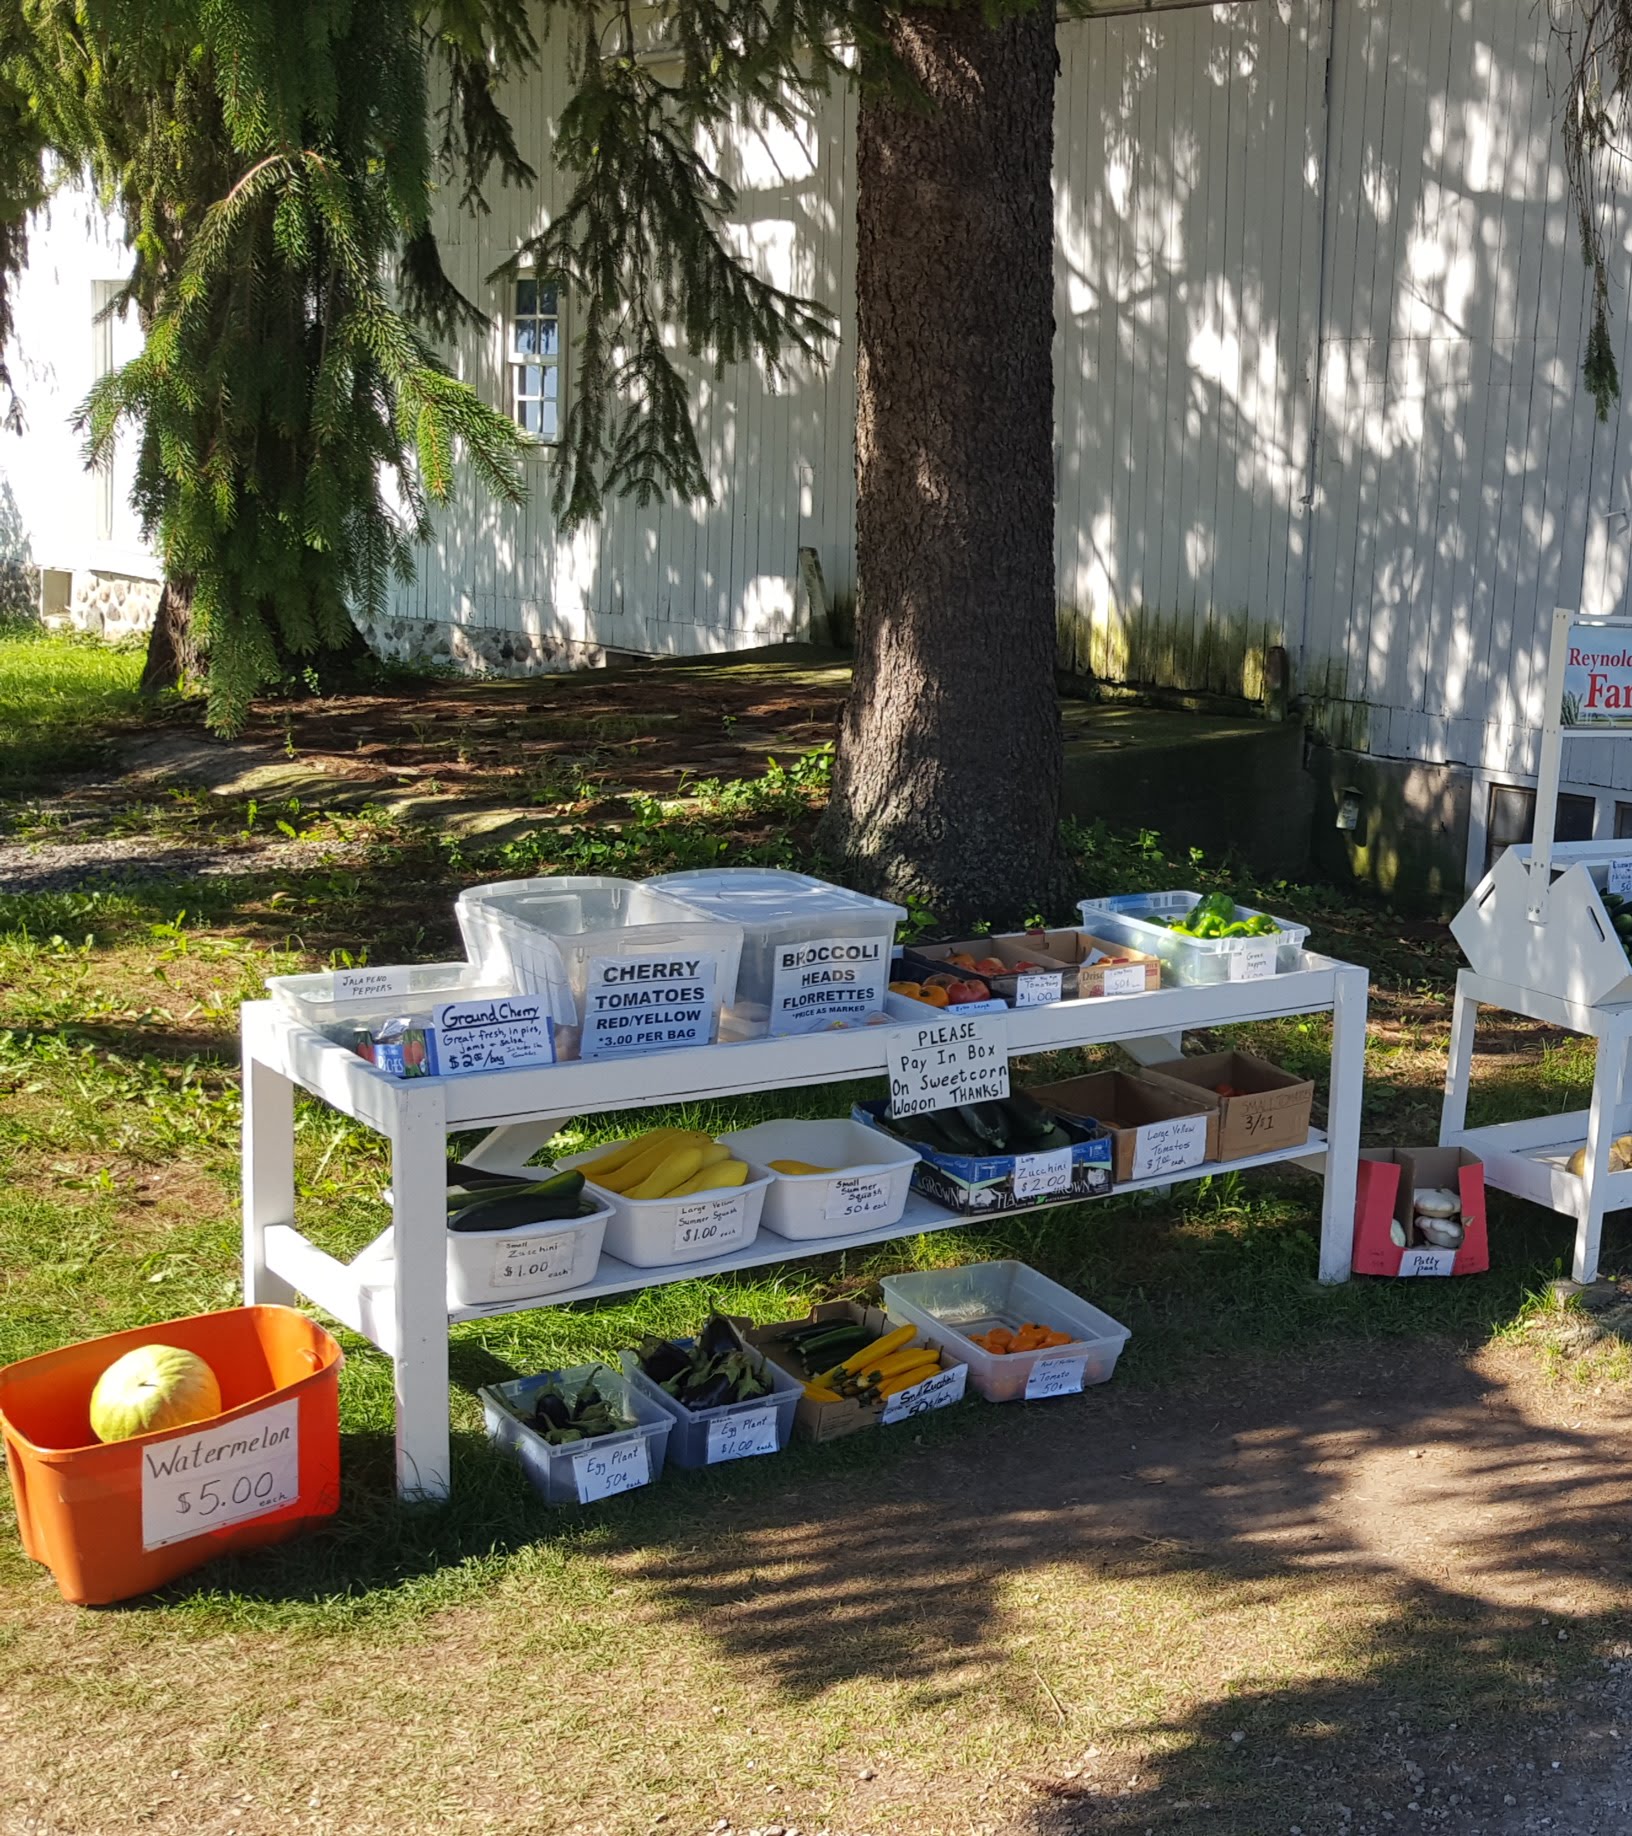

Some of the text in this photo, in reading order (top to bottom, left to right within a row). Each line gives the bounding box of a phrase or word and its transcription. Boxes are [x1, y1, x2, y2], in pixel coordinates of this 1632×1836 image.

[782, 944, 879, 968] BROCCOLI
[603, 960, 700, 983] CHERRY
[801, 969, 856, 986] HEADS
[352, 984, 392, 995] PEPPERS
[595, 987, 705, 1009] TOMATOES
[783, 987, 876, 1009] FLORRETTES
[442, 1002, 539, 1028] Ground Cherry
[815, 1007, 827, 1015] AS
[829, 1005, 865, 1013] MARKED
[596, 1010, 701, 1030] RED/YELLOW
[443, 1032, 475, 1046] Great
[636, 1031, 663, 1043] PER
[667, 1028, 696, 1040] BAG
[918, 1022, 976, 1047] PLEASE
[460, 1041, 485, 1054] jams
[901, 1044, 995, 1074] Pay In Box
[892, 1065, 1007, 1097] On Sweetcorn
[893, 1080, 1003, 1117] Wagon THANKS!
[1147, 1130, 1169, 1143] Large
[1018, 1163, 1068, 1179] Zucchini
[835, 1178, 860, 1189] Small
[841, 1183, 877, 1195] Summer
[1021, 1174, 1066, 1193] $2.00
[848, 1188, 883, 1203] Squash
[682, 1205, 706, 1214] Large
[678, 1216, 710, 1227] Summer
[683, 1225, 718, 1242] $1.00
[506, 1241, 528, 1249] Small
[503, 1261, 569, 1278] $1.00 each
[1413, 1255, 1440, 1268] Patty
[1040, 1370, 1070, 1382] Tomato
[721, 1421, 737, 1438] Egg
[742, 1416, 767, 1430] Plant
[146, 1426, 290, 1479] Watermelon
[721, 1440, 773, 1455] $1.00 each
[587, 1446, 638, 1476] Egg Plant
[176, 1471, 287, 1515] $5.00 each
